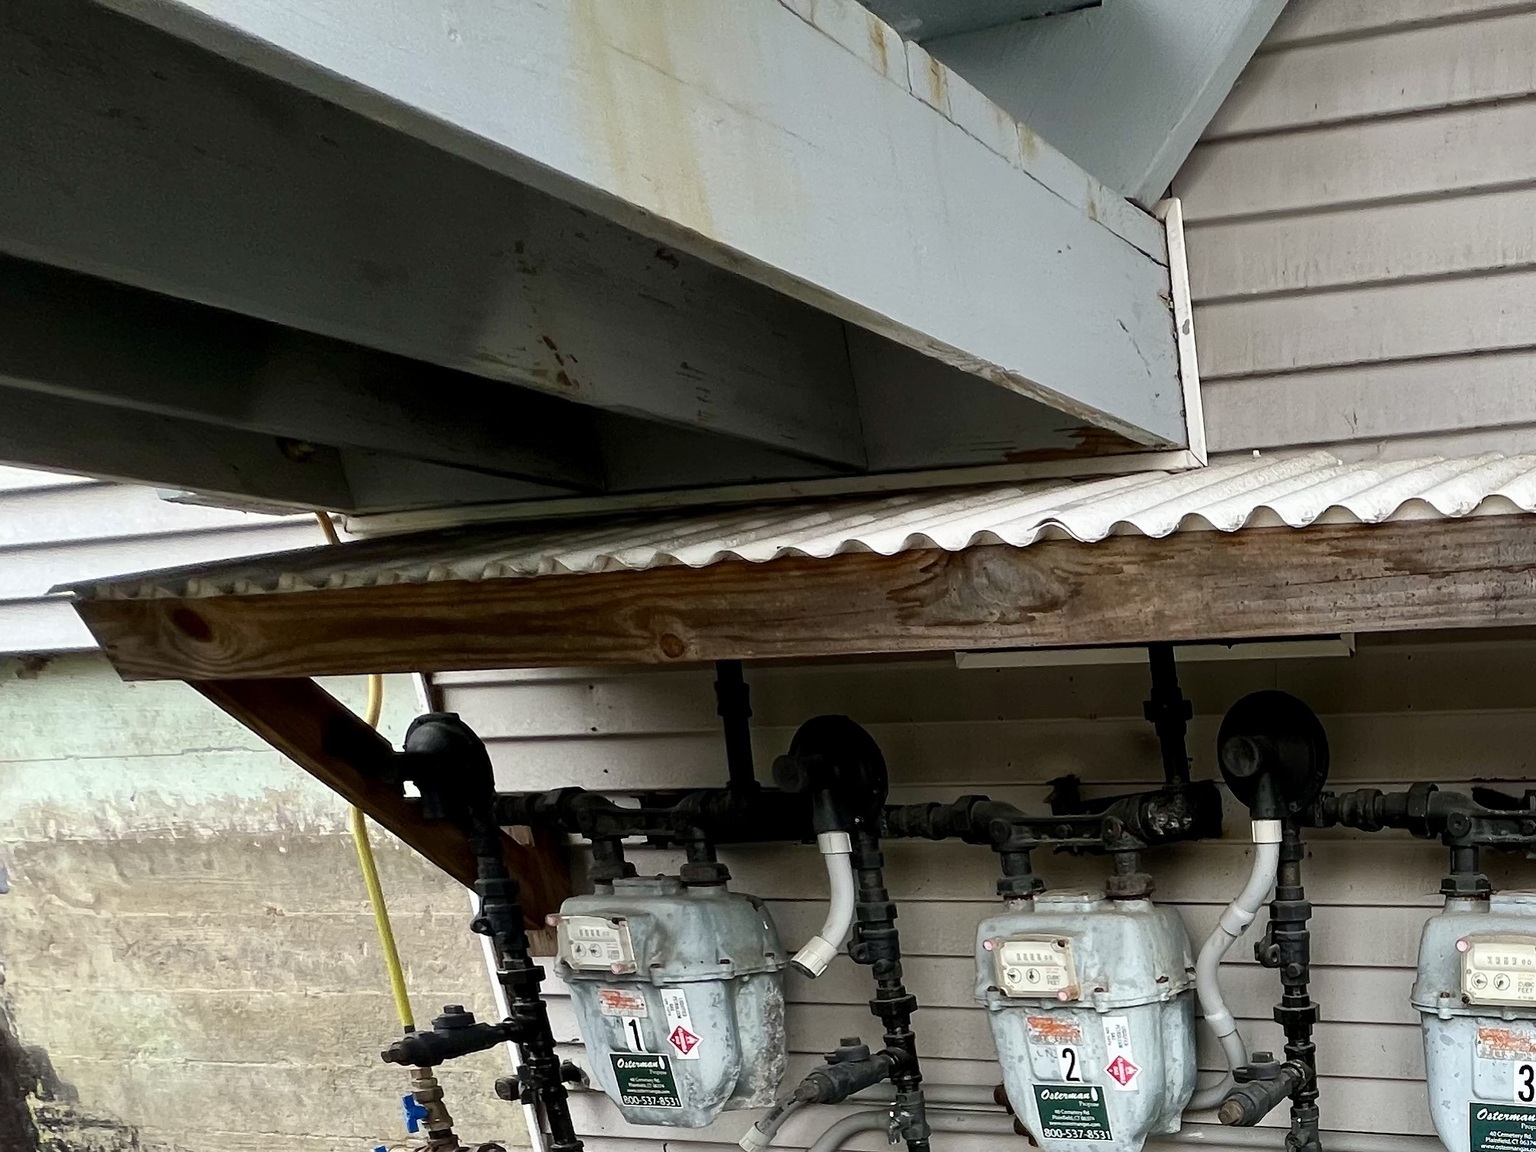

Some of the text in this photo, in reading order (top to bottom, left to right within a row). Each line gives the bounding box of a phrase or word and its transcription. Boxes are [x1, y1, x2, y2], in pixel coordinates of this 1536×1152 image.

[628, 1019, 643, 1051] 1
[617, 1058, 658, 1069] Osterman
[1062, 1048, 1080, 1081] 2
[1518, 1064, 1535, 1102] 3
[623, 1095, 680, 1106] 800-537-8531
[1041, 1089, 1090, 1100] Osterman
[1477, 1108, 1536, 1121] Osterman
[1044, 1128, 1111, 1140] 800-537-8531
[1497, 1131, 1523, 1139] Cemetery
